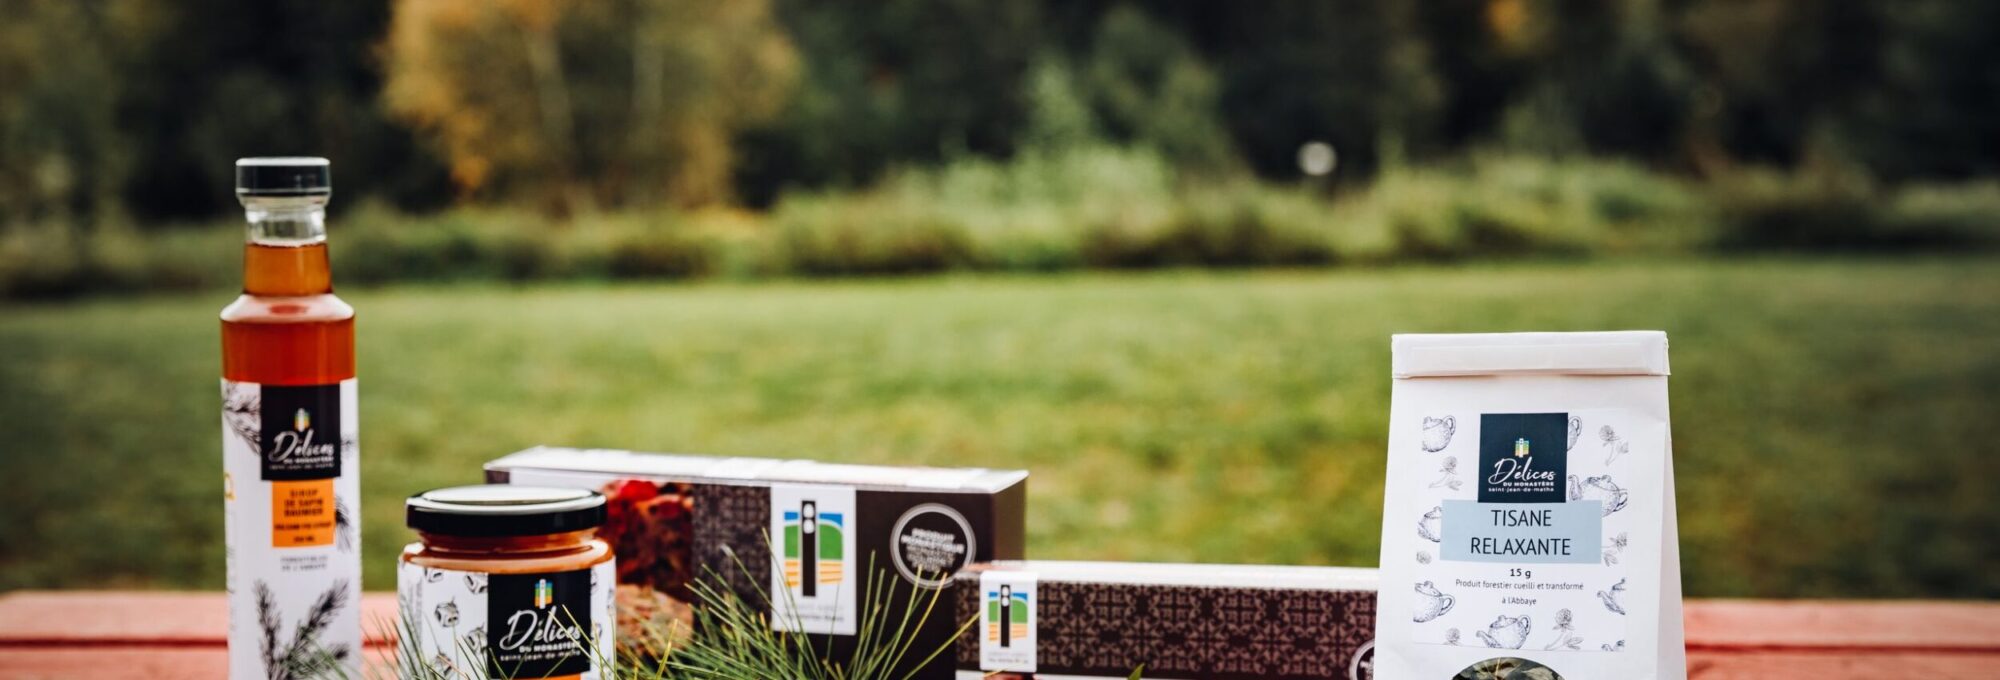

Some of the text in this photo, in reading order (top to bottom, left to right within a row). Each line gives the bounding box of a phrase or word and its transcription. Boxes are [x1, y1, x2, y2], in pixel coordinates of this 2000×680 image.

[1488, 456, 1556, 485] Délices
[1491, 509, 1552, 527] TISANE
[1470, 537, 1571, 556] RELAXANTE
[1510, 568, 1532, 579] 15 g
[1456, 579, 1481, 588] Produit
[1483, 580, 1512, 589] forestier
[1514, 581, 1535, 590] cueilli
[1545, 582, 1584, 591] transformé
[1508, 596, 1537, 605] l'Abbaye
[499, 605, 581, 650] Délices
[519, 645, 531, 653] DU
